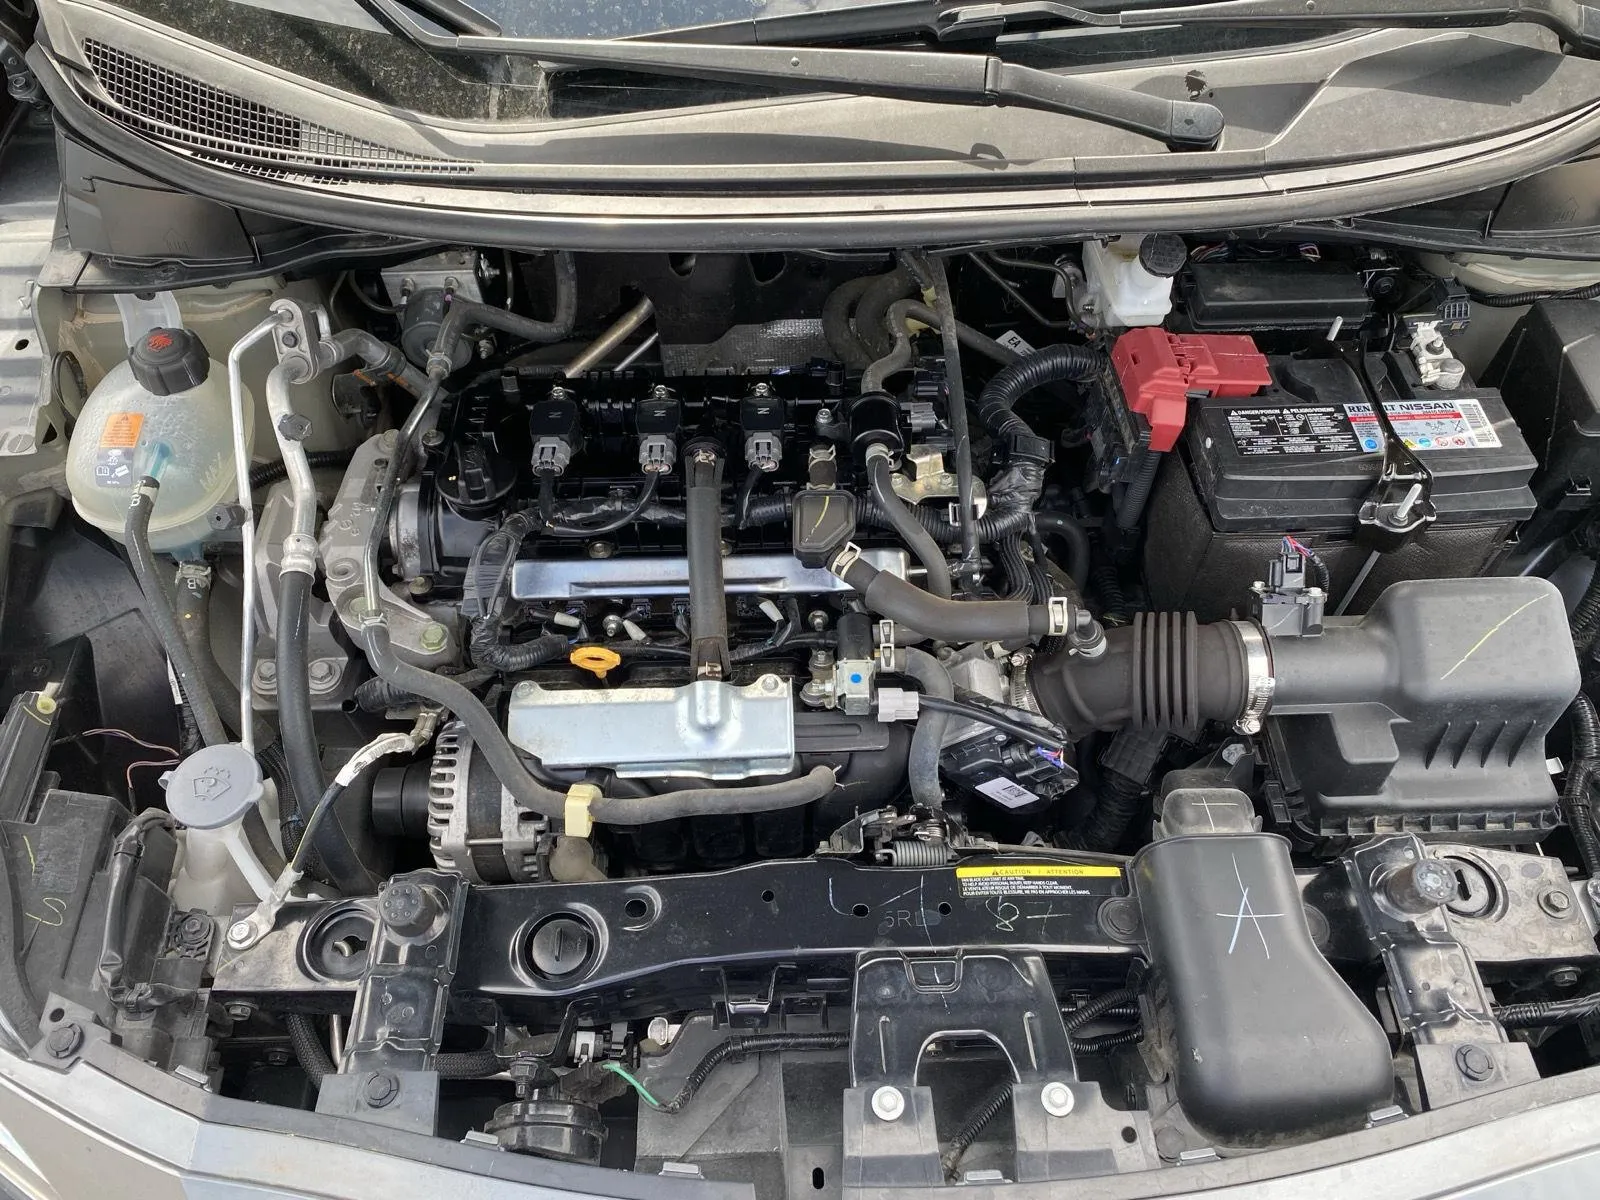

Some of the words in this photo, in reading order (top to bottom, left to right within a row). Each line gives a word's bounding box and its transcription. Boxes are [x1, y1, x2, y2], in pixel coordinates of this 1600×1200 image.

[1008, 336, 1021, 348] EA
[1348, 403, 1396, 413] RENLT
[1400, 402, 1454, 410] NISSAN
